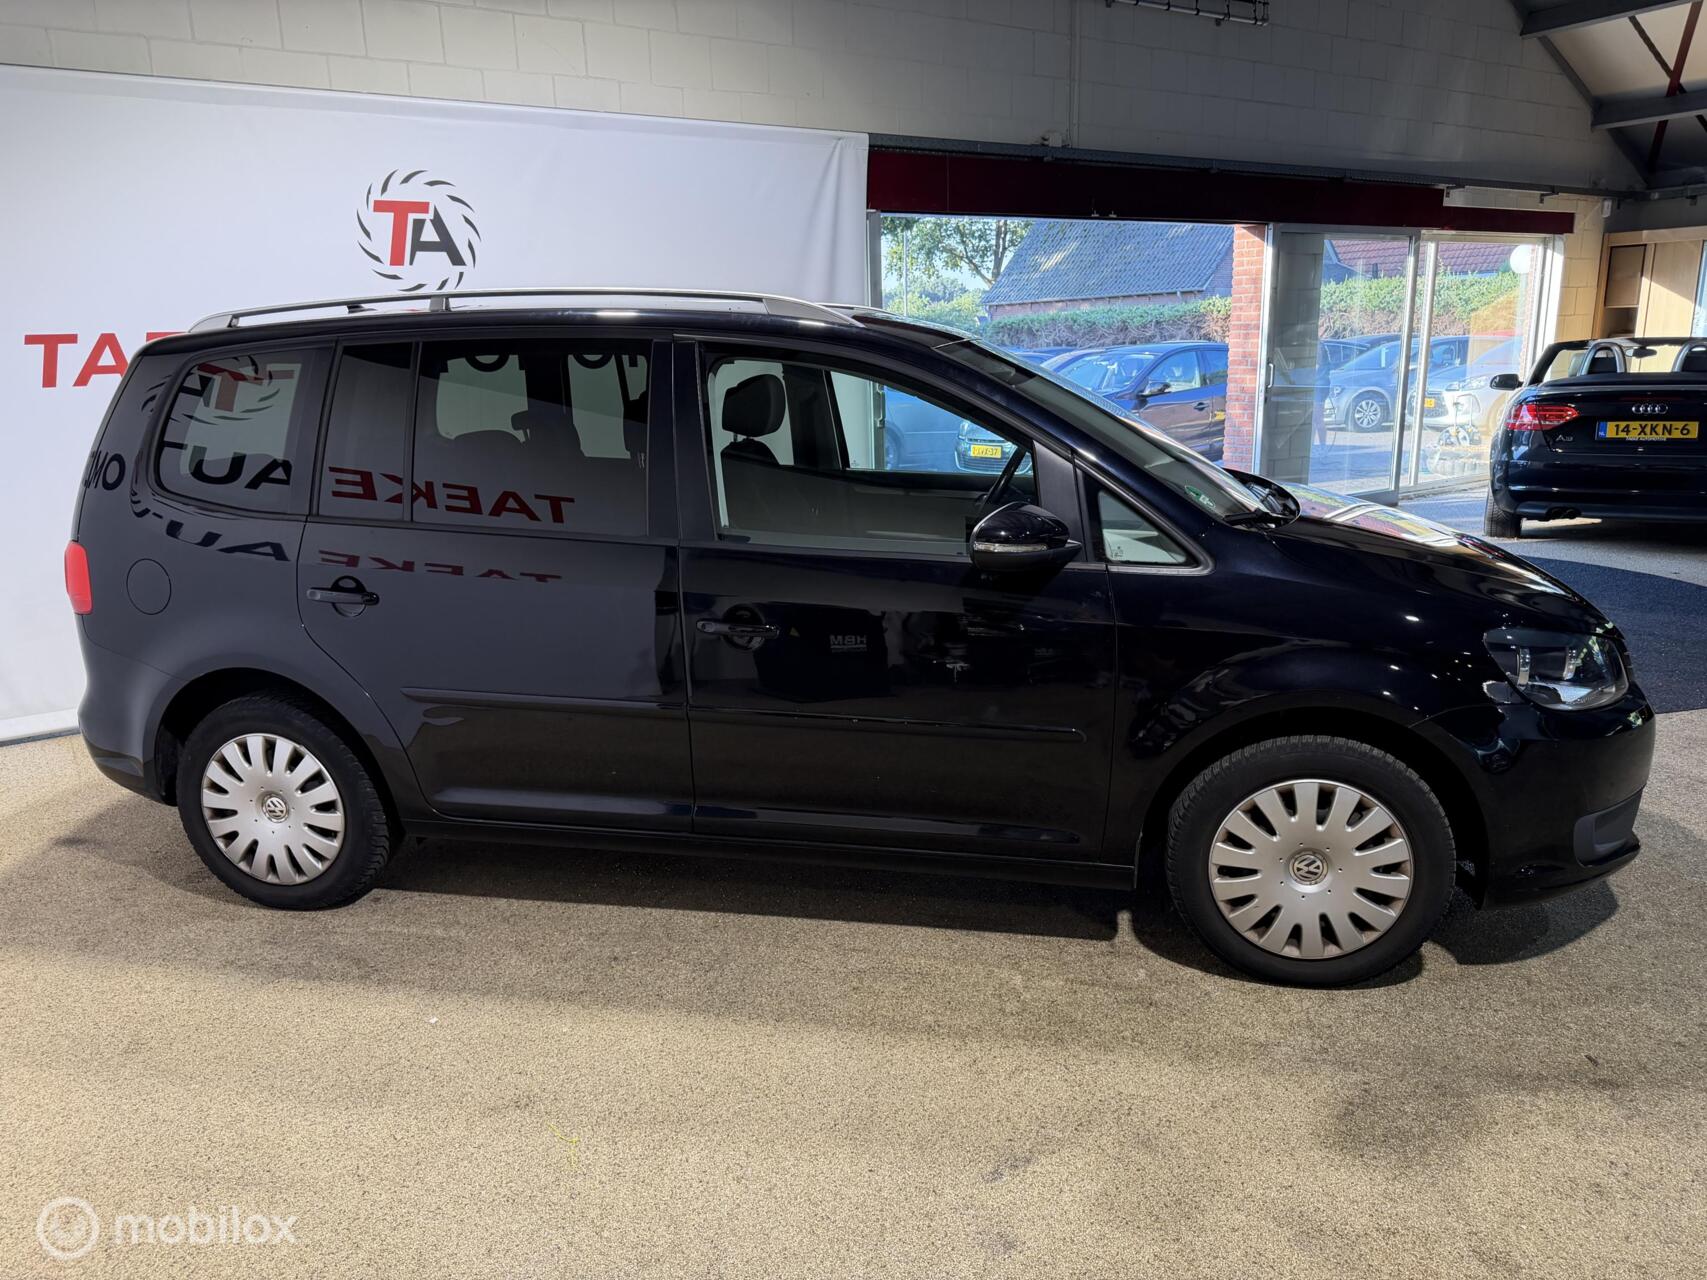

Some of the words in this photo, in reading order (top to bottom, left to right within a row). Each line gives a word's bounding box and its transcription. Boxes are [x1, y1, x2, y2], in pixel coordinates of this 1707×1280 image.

[373, 200, 466, 266] TA
[24, 331, 186, 389] TA
[1614, 423, 1690, 436] 14-XKN-6
